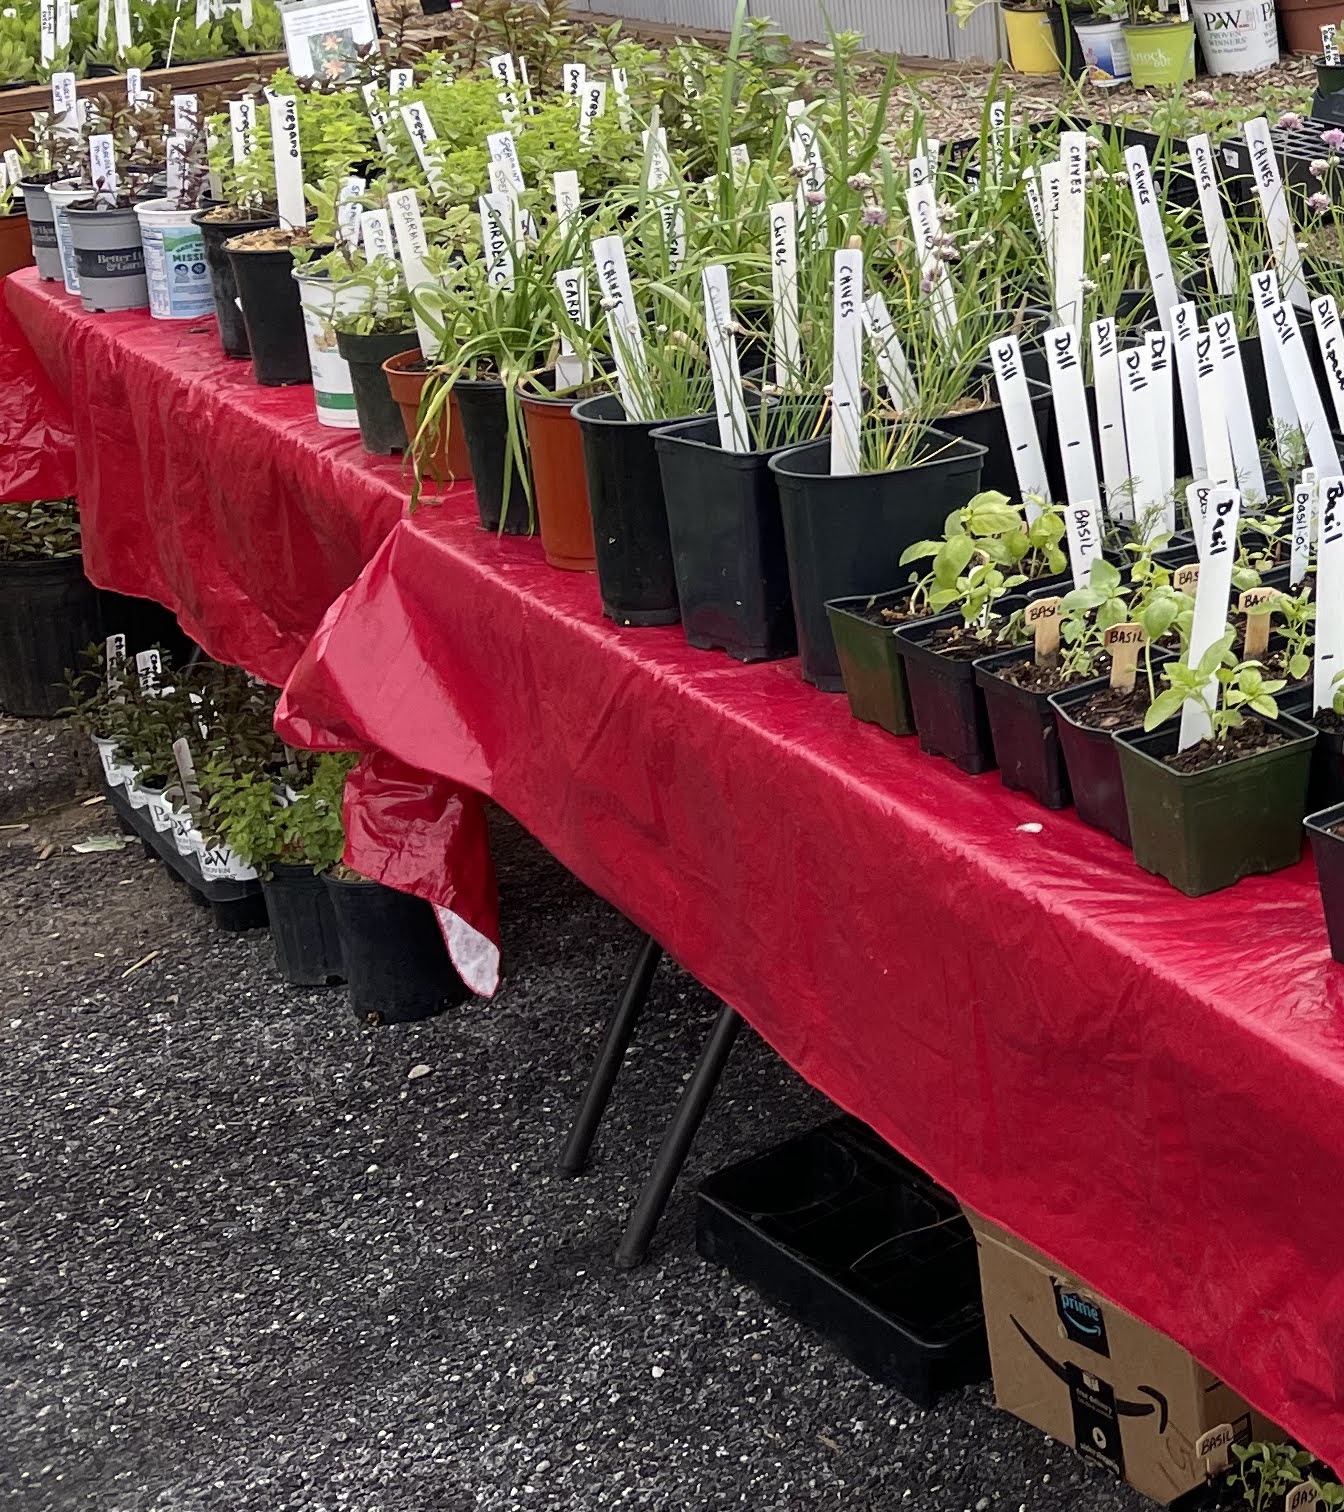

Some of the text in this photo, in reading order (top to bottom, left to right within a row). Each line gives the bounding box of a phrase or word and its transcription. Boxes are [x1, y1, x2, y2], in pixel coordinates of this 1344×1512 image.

[285, 99, 298, 158] Oregano
[1070, 145, 1083, 195] CHIVES
[1132, 161, 1150, 206] CHIVES
[1195, 147, 1211, 192] CHIVES
[1253, 139, 1274, 189] CHIVES
[838, 265, 855, 319] CHIVES
[1257, 273, 1276, 309] Dill
[1175, 307, 1191, 342] Dill
[1272, 308, 1295, 345] Dill
[1318, 299, 1336, 329] Dill
[1054, 332, 1077, 370] Dill
[1097, 321, 1114, 358] Dill
[1151, 336, 1167, 371] Dill
[1196, 336, 1214, 378] Dill
[1214, 316, 1236, 359] Dill
[997, 343, 1018, 381] Dill
[1125, 350, 1149, 392] Dill
[1073, 509, 1093, 556] BASIL
[1209, 498, 1234, 557] Basil
[1296, 492, 1309, 533] Basil
[1324, 480, 1344, 544] Basil
[1108, 629, 1145, 644] BASIL
[1060, 1292, 1100, 1321] prime
[1201, 1432, 1233, 1457] BASIL
